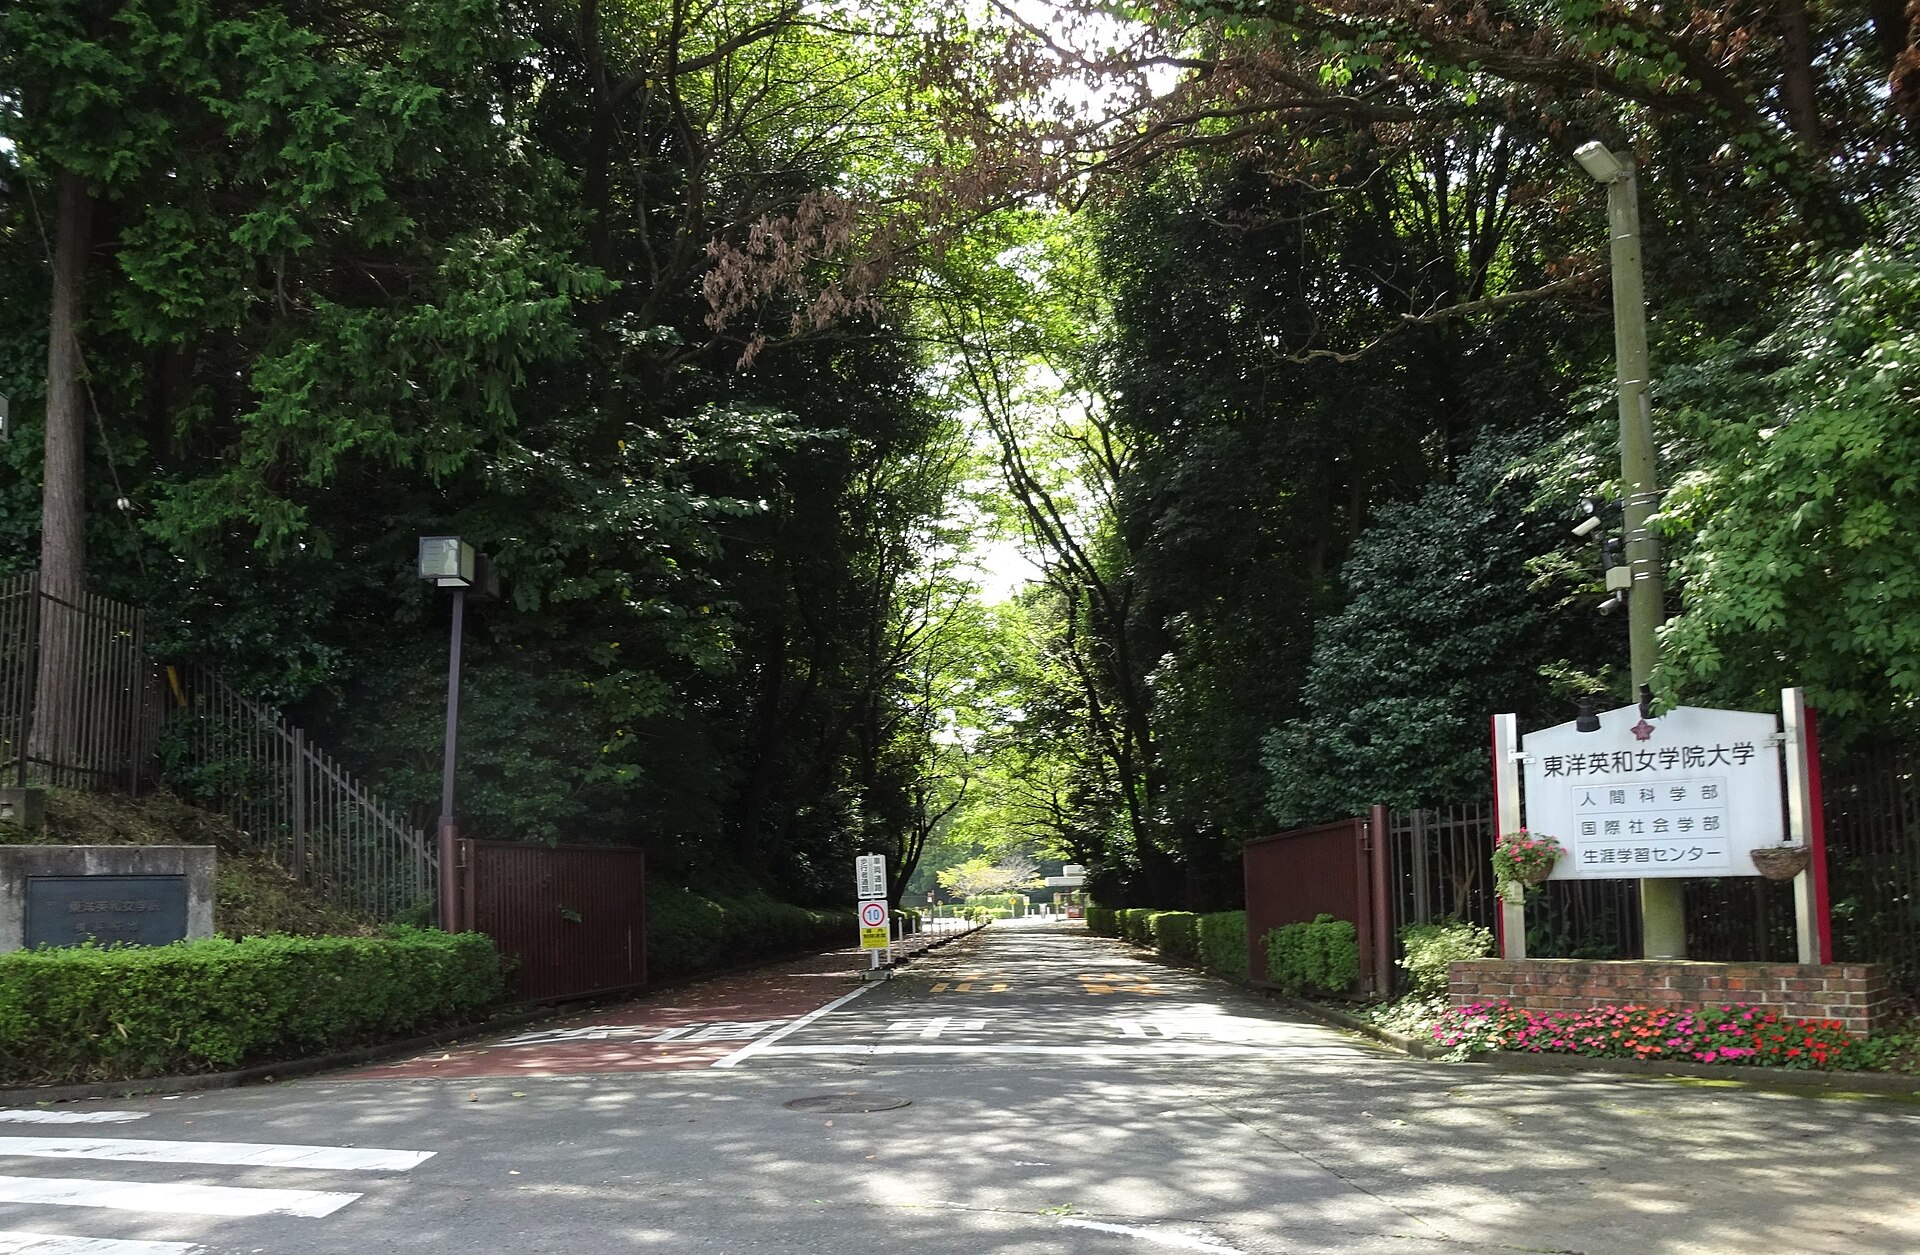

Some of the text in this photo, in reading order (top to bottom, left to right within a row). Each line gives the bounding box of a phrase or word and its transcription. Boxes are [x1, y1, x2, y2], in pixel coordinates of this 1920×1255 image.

[1543, 741, 1755, 778] 東洋英和女学院大学
[1580, 784, 1719, 807] 人間科学部
[1581, 815, 1720, 836] 国際社会学部
[1582, 845, 1722, 865] 生涯学習センター
[866, 909, 880, 921] 10
